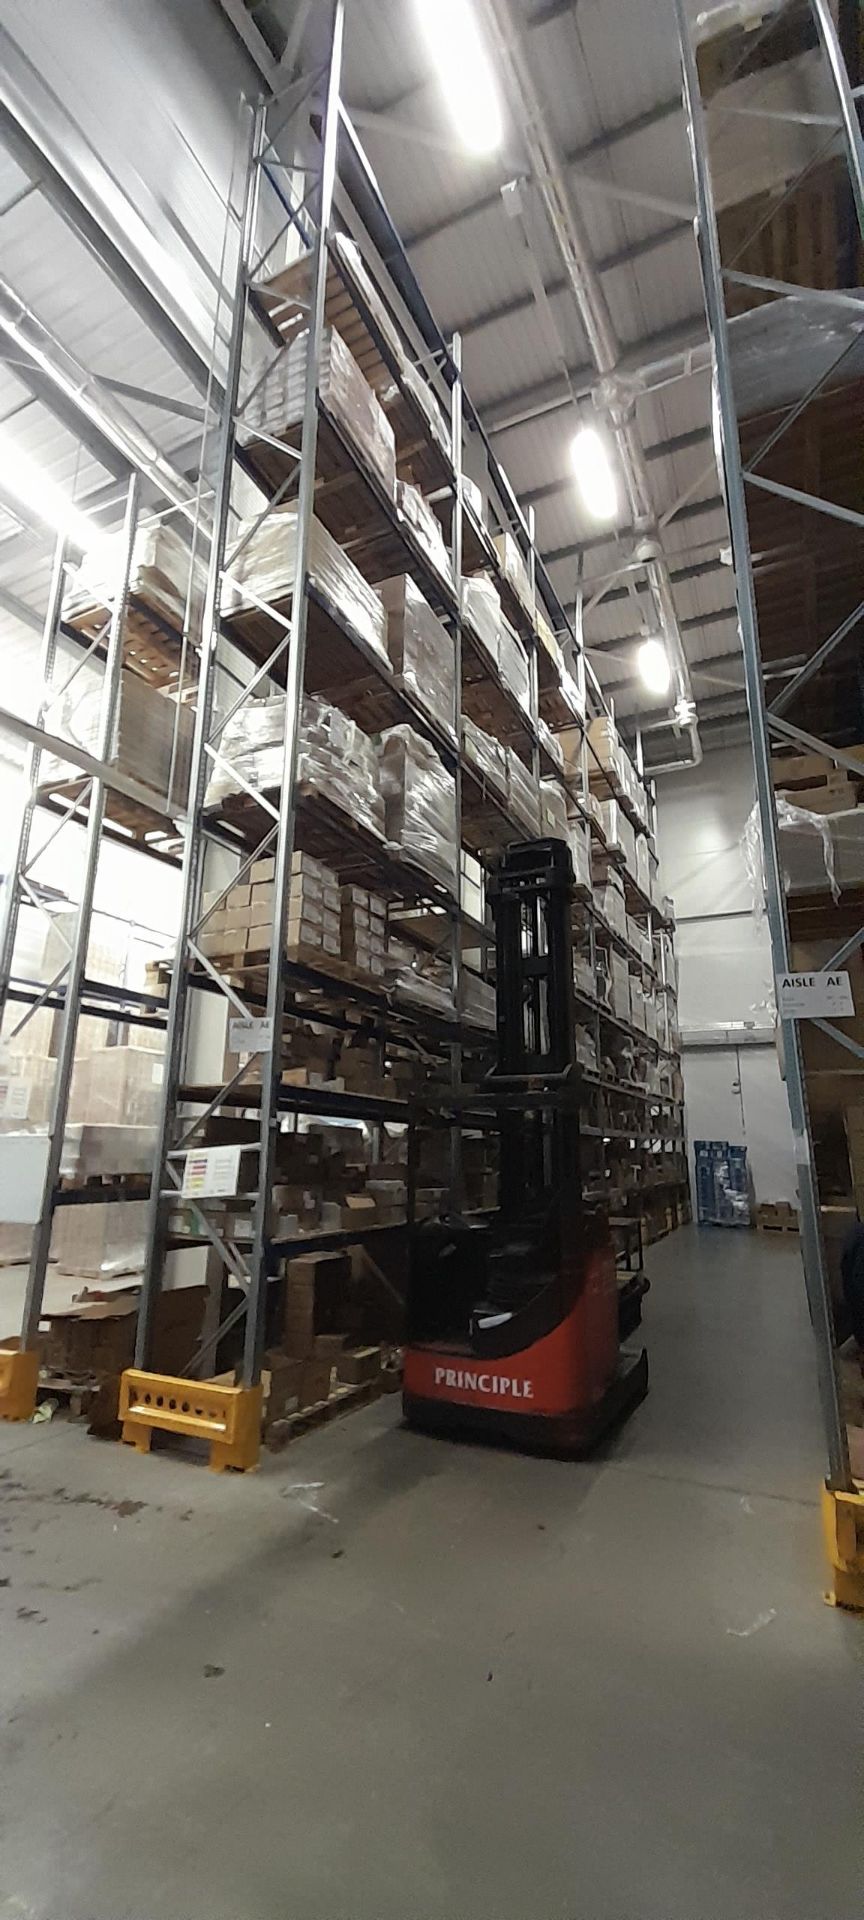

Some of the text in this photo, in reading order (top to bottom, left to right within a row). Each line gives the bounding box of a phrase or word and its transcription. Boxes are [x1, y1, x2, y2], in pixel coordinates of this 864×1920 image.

[782, 976, 843, 988] AISLE AE
[435, 1367, 534, 1398] PRINCIPLE
